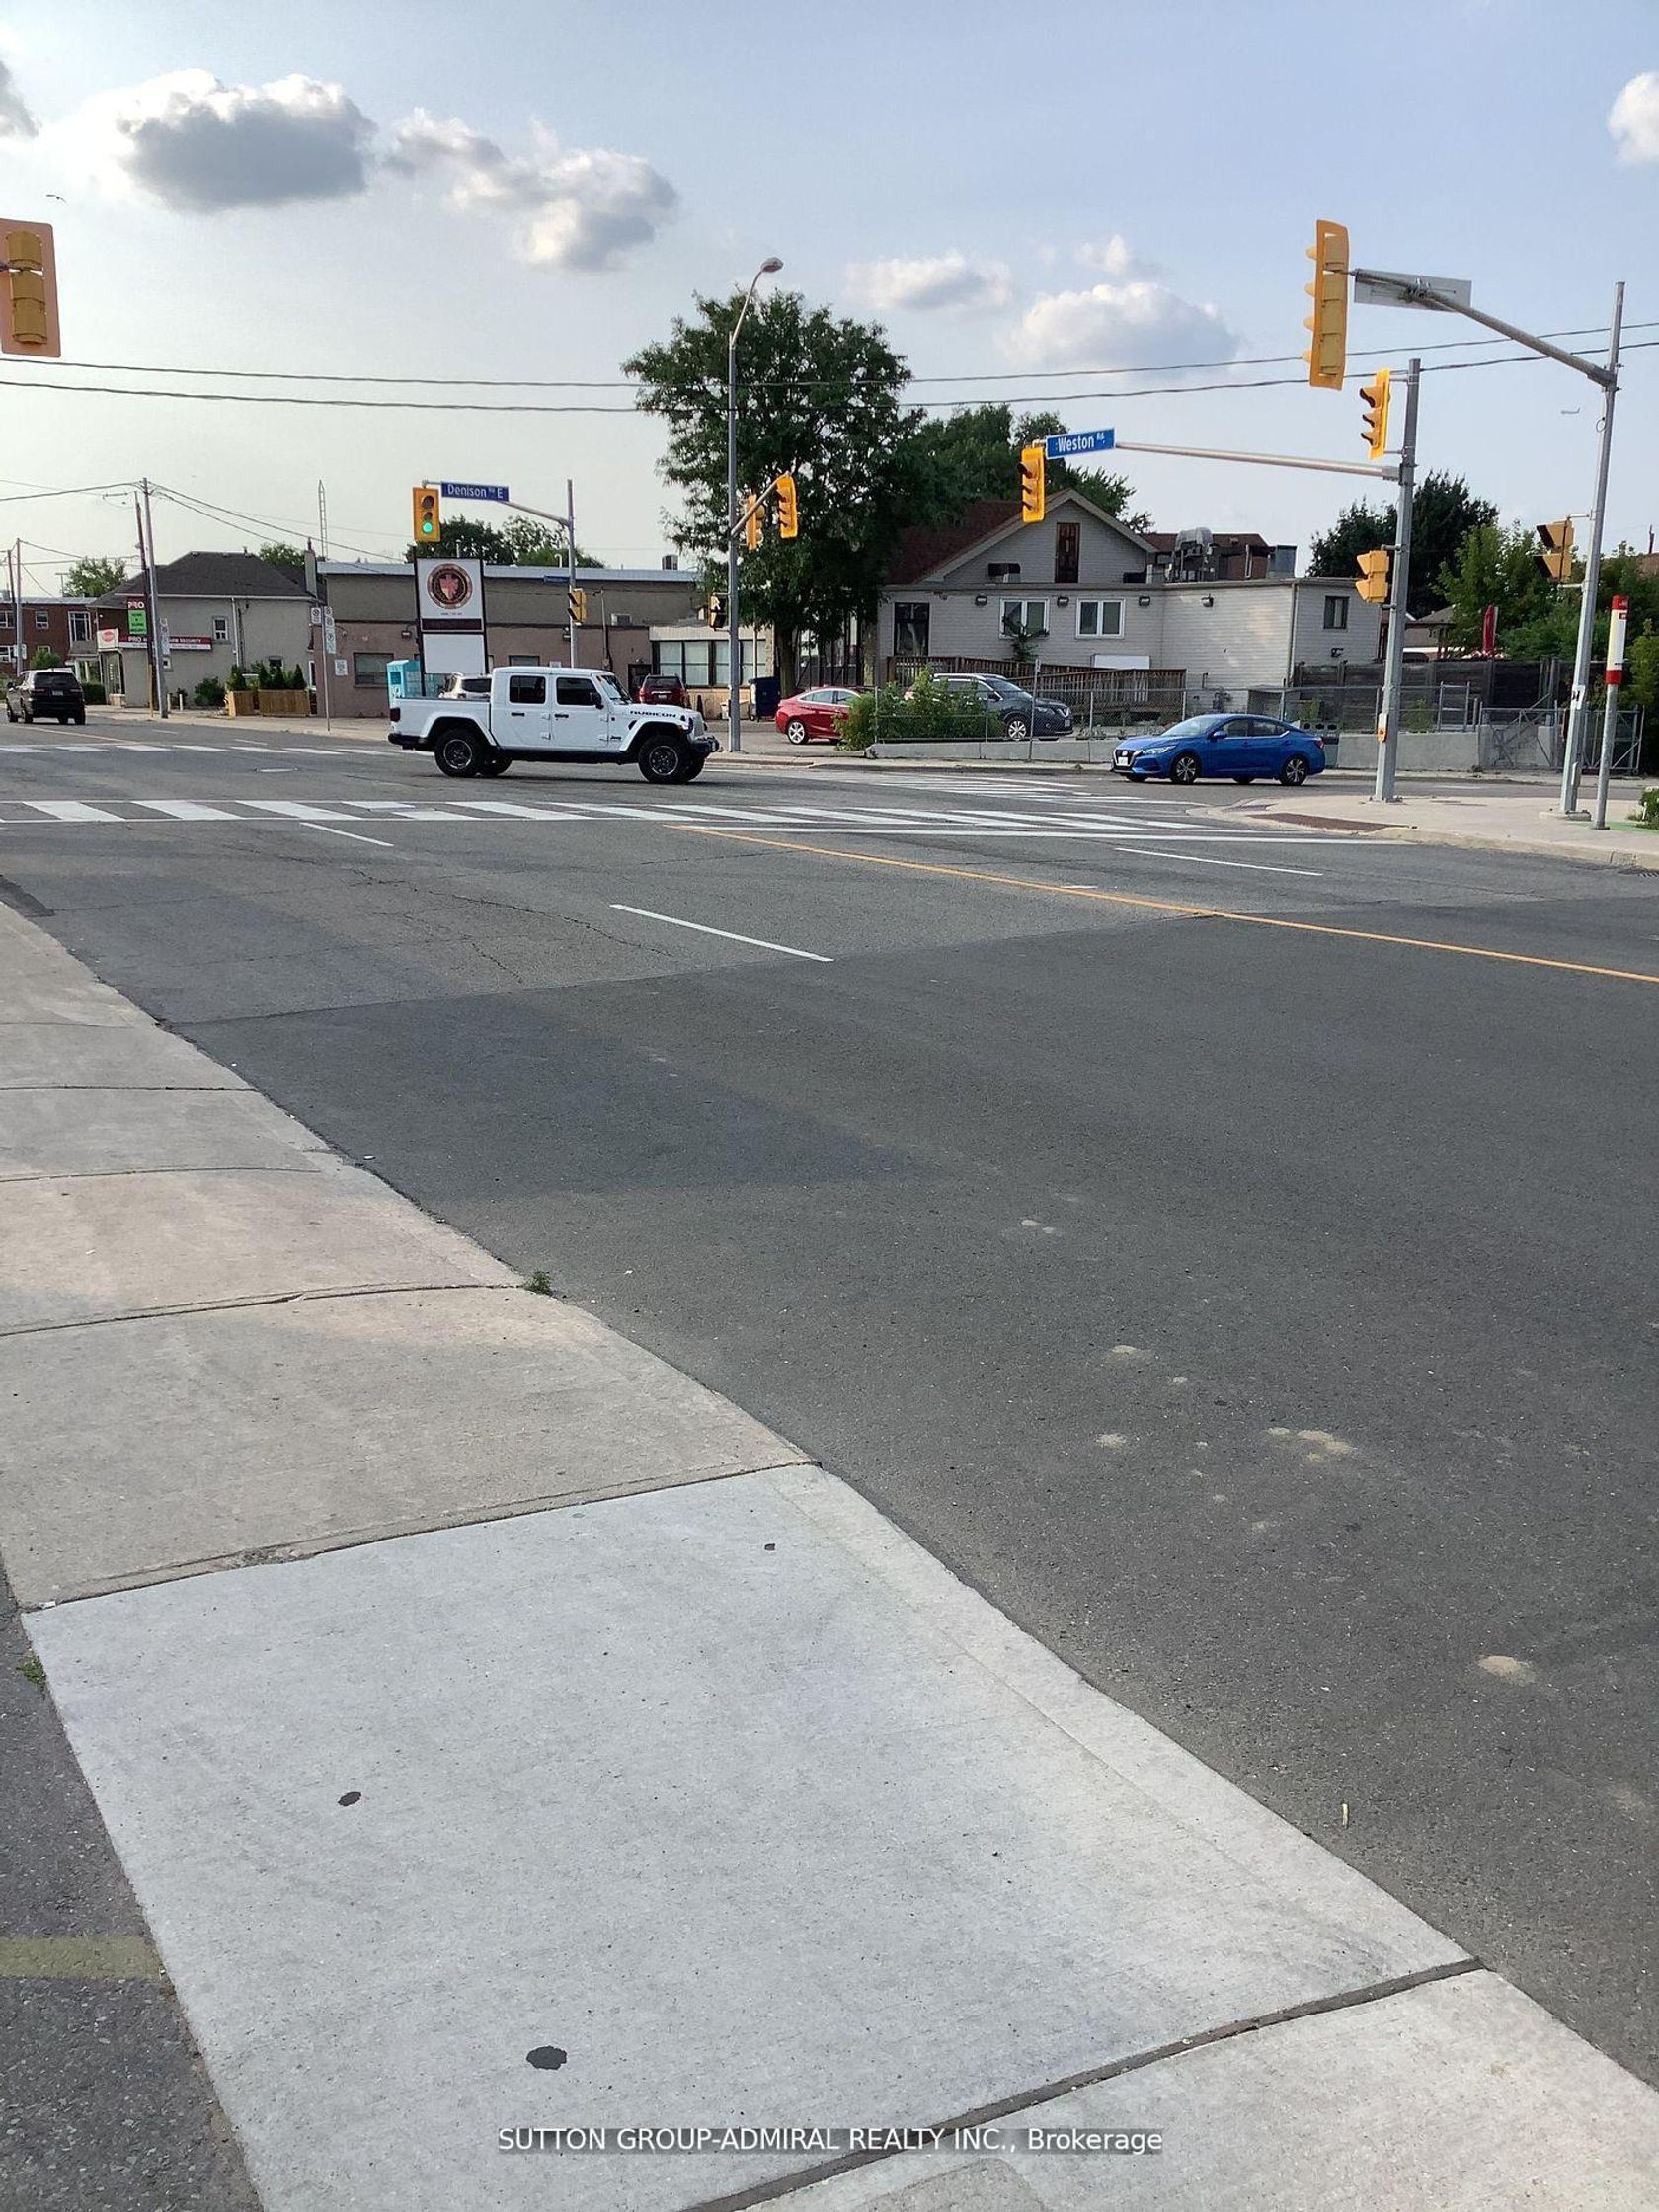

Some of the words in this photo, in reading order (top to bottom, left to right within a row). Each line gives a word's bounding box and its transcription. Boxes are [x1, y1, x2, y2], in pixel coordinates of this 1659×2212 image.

[1058, 435, 1095, 453] Weston
[447, 483, 487, 498] Denison
[497, 487, 504, 499] E
